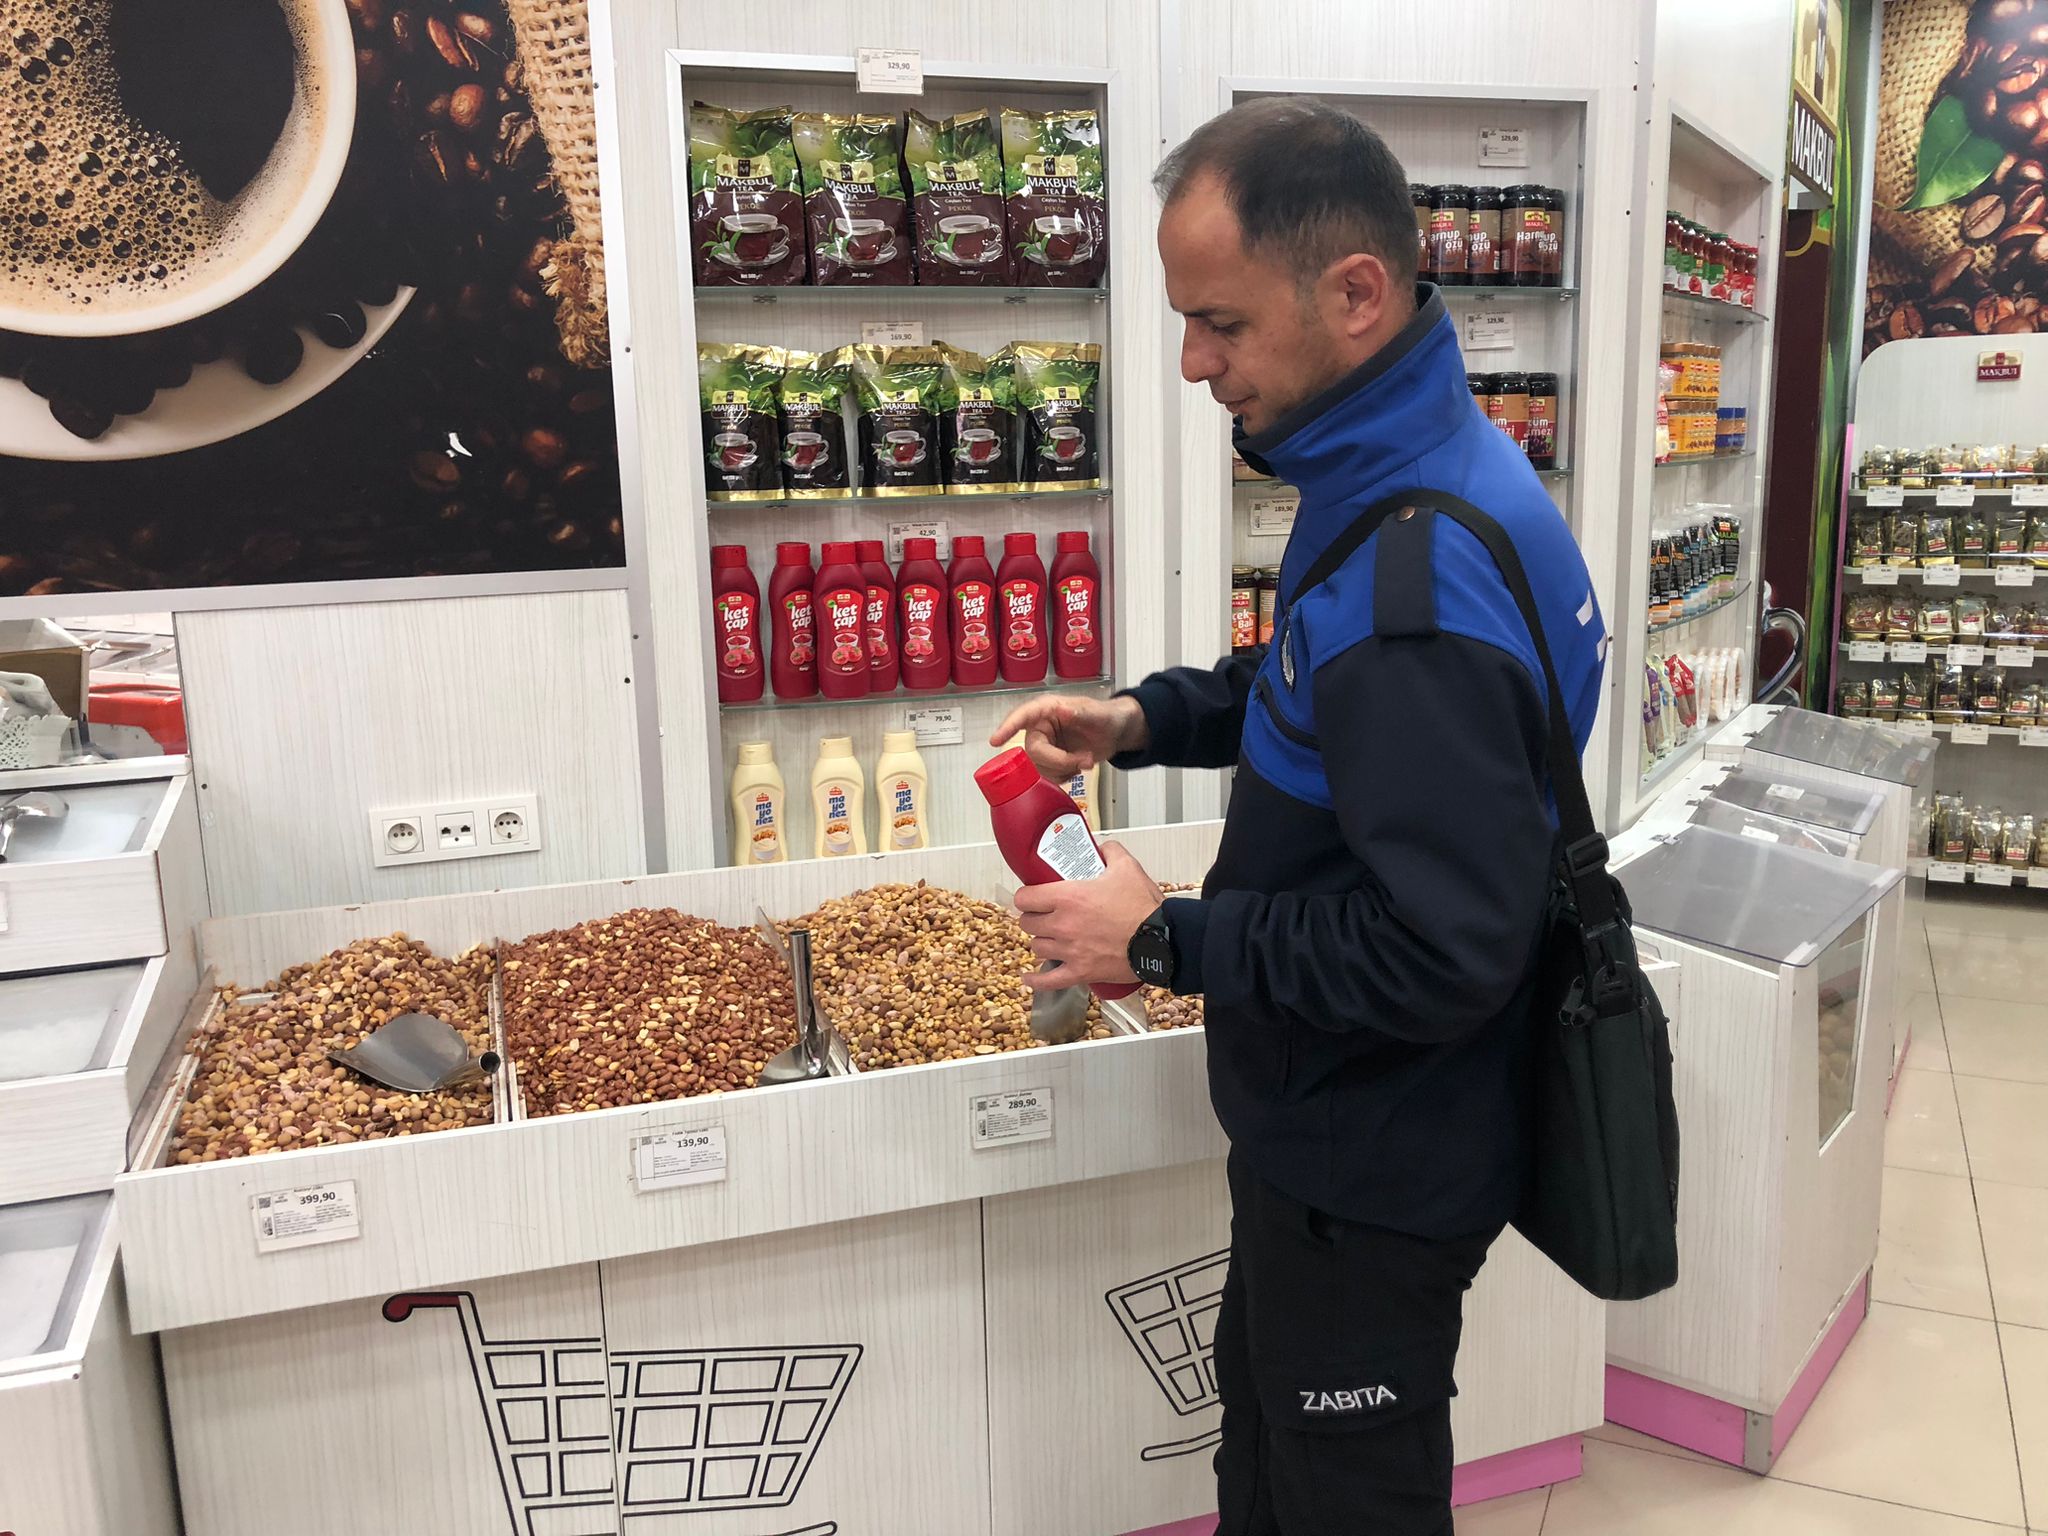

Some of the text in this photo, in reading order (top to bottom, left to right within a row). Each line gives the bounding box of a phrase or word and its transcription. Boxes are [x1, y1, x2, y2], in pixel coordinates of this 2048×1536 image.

[1792, 100, 1835, 196] MAKBUL
[717, 176, 773, 187] MAKBUL
[826, 179, 875, 194] MAKBUL
[929, 181, 979, 191] MAKBUL
[1027, 177, 1077, 188] MAKBUL
[1045, 187, 1059, 195] TEA
[1430, 230, 1460, 243] arnup
[960, 401, 993, 409] MAKBUL
[962, 595, 985, 610] ket
[1009, 593, 1033, 608] ket
[1066, 589, 1089, 604] ket
[791, 603, 812, 620] ket
[833, 602, 858, 618] ket
[868, 600, 884, 612] et
[908, 598, 933, 612] ket
[1010, 604, 1032, 619] çap
[1067, 600, 1088, 615] çap
[724, 605, 749, 621] ket
[866, 610, 883, 623] ap
[909, 609, 931, 623] çap
[964, 605, 985, 620] çap
[726, 617, 749, 632] çap
[792, 616, 812, 631] çap
[834, 614, 856, 630] çap
[935, 714, 952, 722] 79,90
[828, 795, 846, 804] ma
[895, 789, 912, 798] ma
[755, 801, 772, 811] ma
[832, 802, 845, 812] yo
[899, 795, 912, 806] yo
[758, 808, 772, 819] yo
[828, 810, 847, 819] nez
[895, 803, 913, 813] nez
[755, 816, 774, 826] nez
[1008, 1097, 1037, 1109] 289,90
[677, 1136, 709, 1148] 139,90
[300, 1191, 336, 1205] 399,90
[1299, 1384, 1398, 1411] ZABITA
